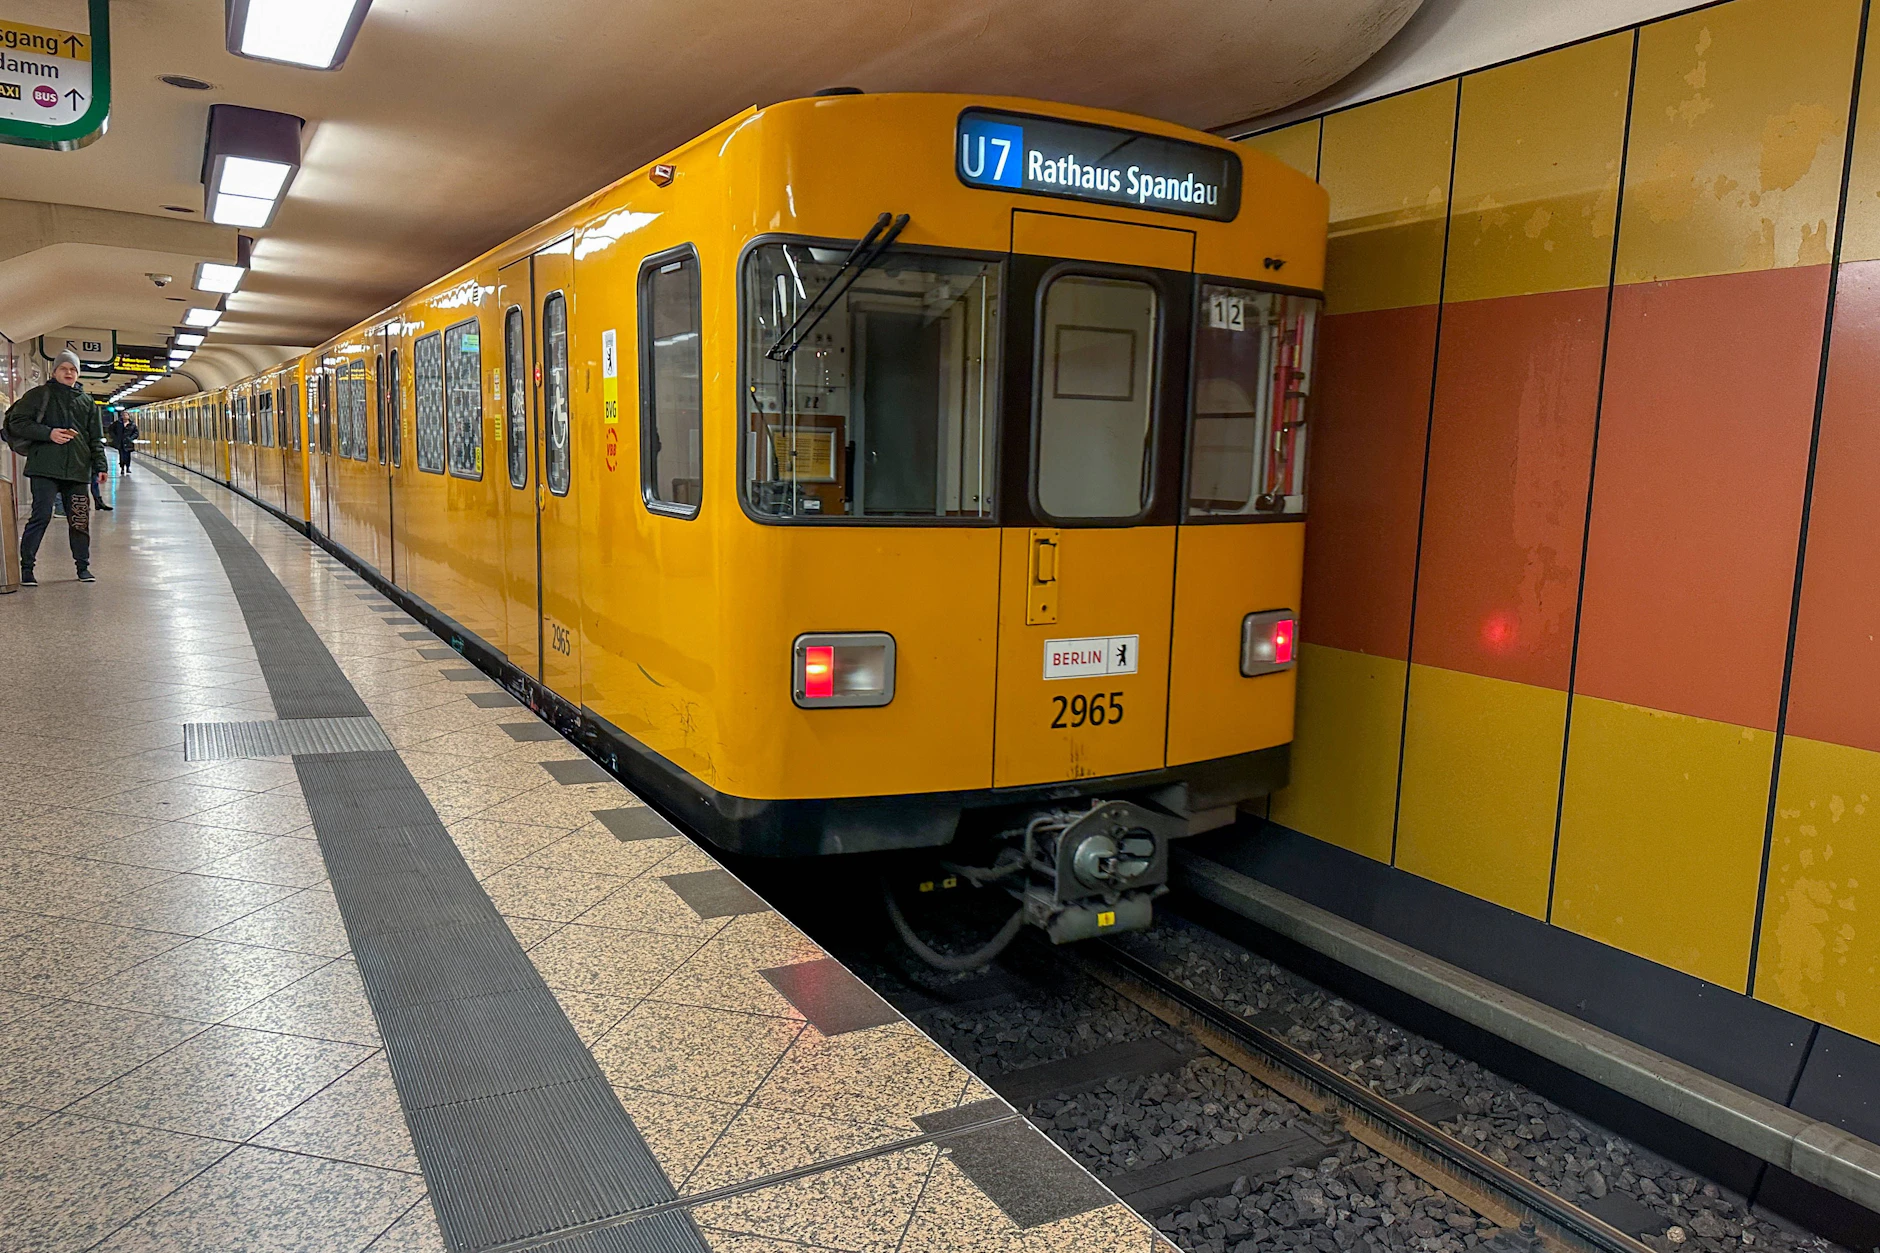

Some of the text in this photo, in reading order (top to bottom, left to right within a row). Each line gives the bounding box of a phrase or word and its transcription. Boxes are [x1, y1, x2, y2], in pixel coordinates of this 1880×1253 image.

[34, 91, 57, 103] BUS
[1028, 150, 1121, 193] Rathaus
[1127, 166, 1218, 206] Spandau
[1214, 301, 1242, 325] 12
[84, 342, 100, 352] U3
[605, 400, 617, 419] BVG
[606, 443, 617, 457] VBB
[552, 623, 571, 657] 2965
[1053, 651, 1102, 666] BERLIN
[1051, 691, 1124, 729] 2965
